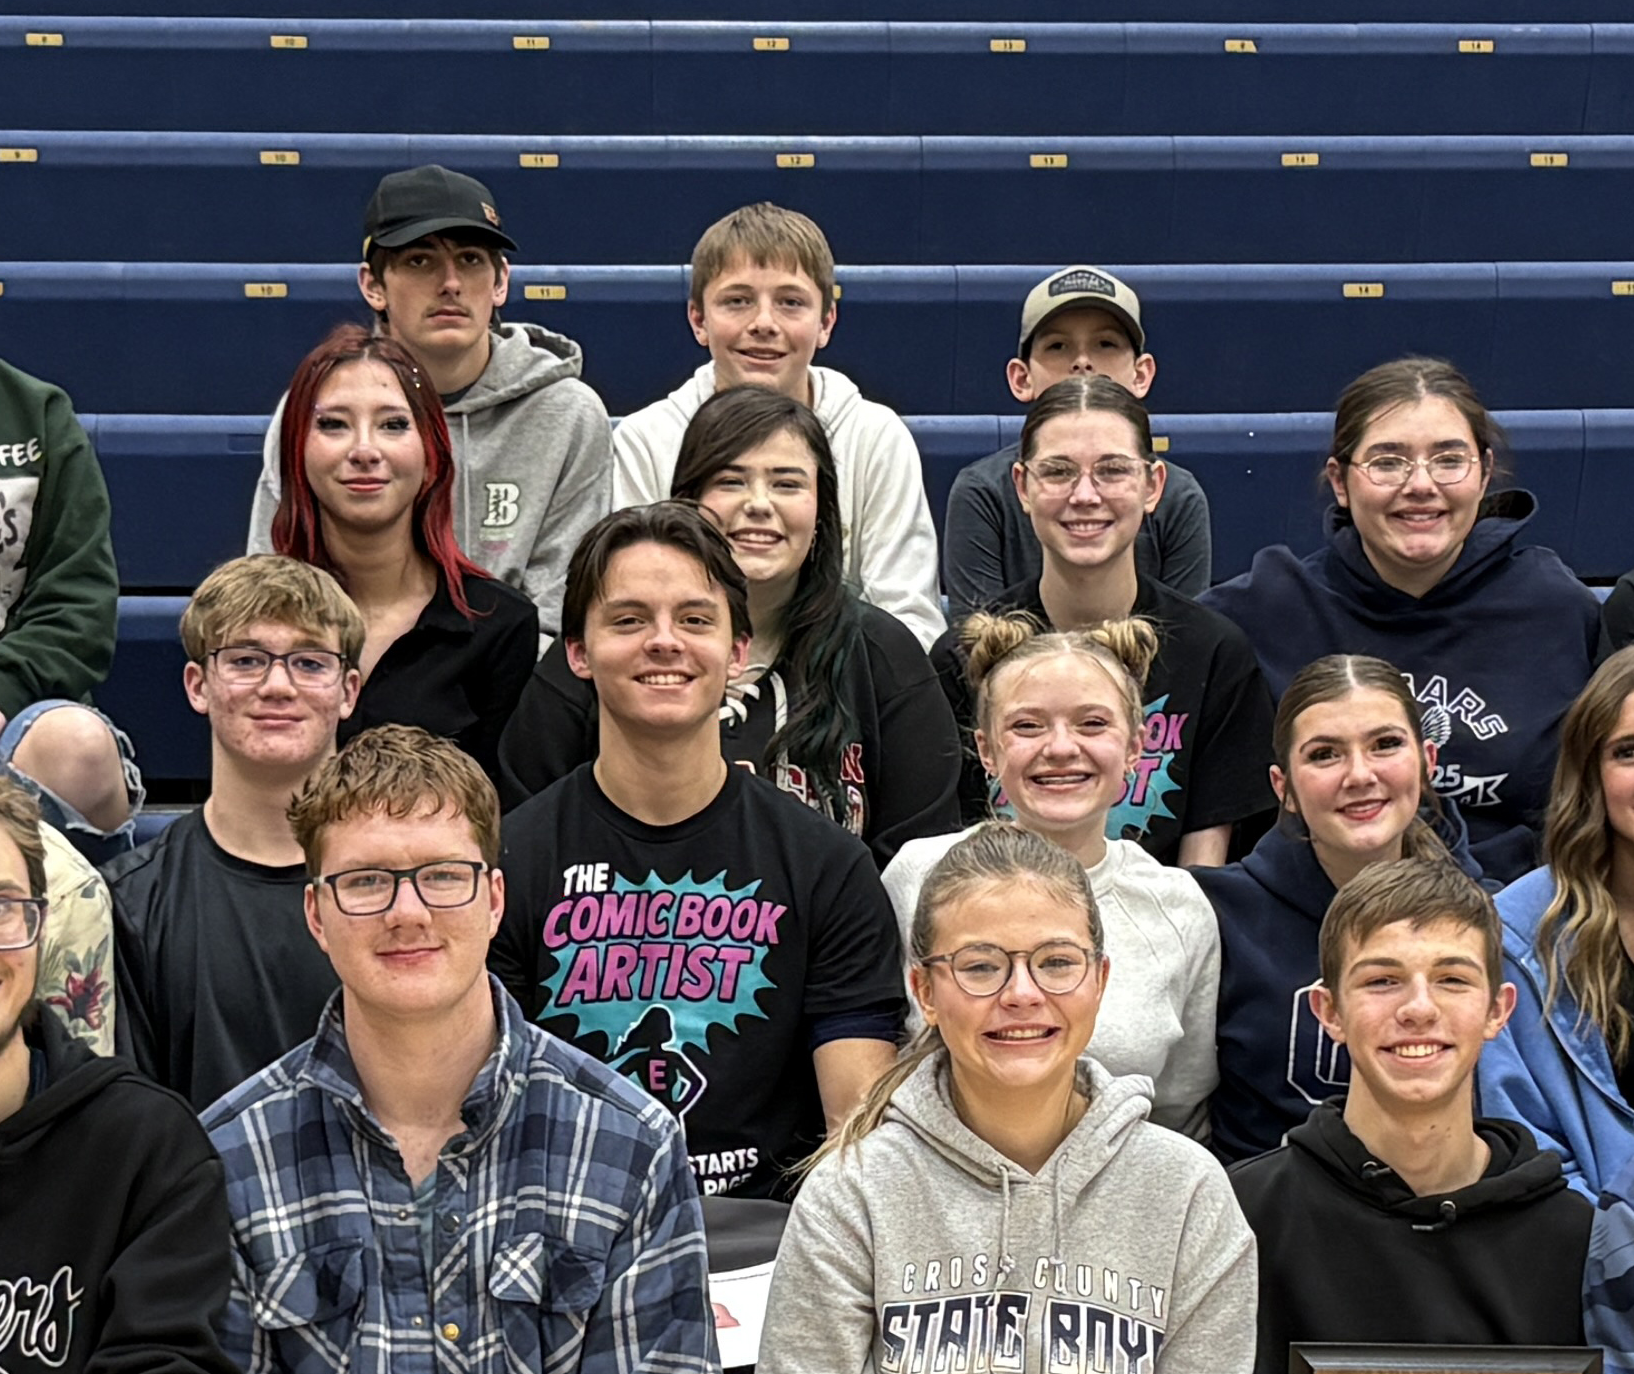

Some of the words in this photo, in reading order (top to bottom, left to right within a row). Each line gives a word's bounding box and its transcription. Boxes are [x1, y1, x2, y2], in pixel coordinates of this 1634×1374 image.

[481, 482, 520, 528] B
[1400, 673, 1509, 741] ARS
[563, 863, 610, 896] THE
[542, 892, 673, 948] COMIC
[675, 895, 788, 946] BOOK
[558, 943, 754, 1004] ARTIST
[649, 1060, 667, 1091] E
[1032, 1256, 1165, 1318] COUNTY
